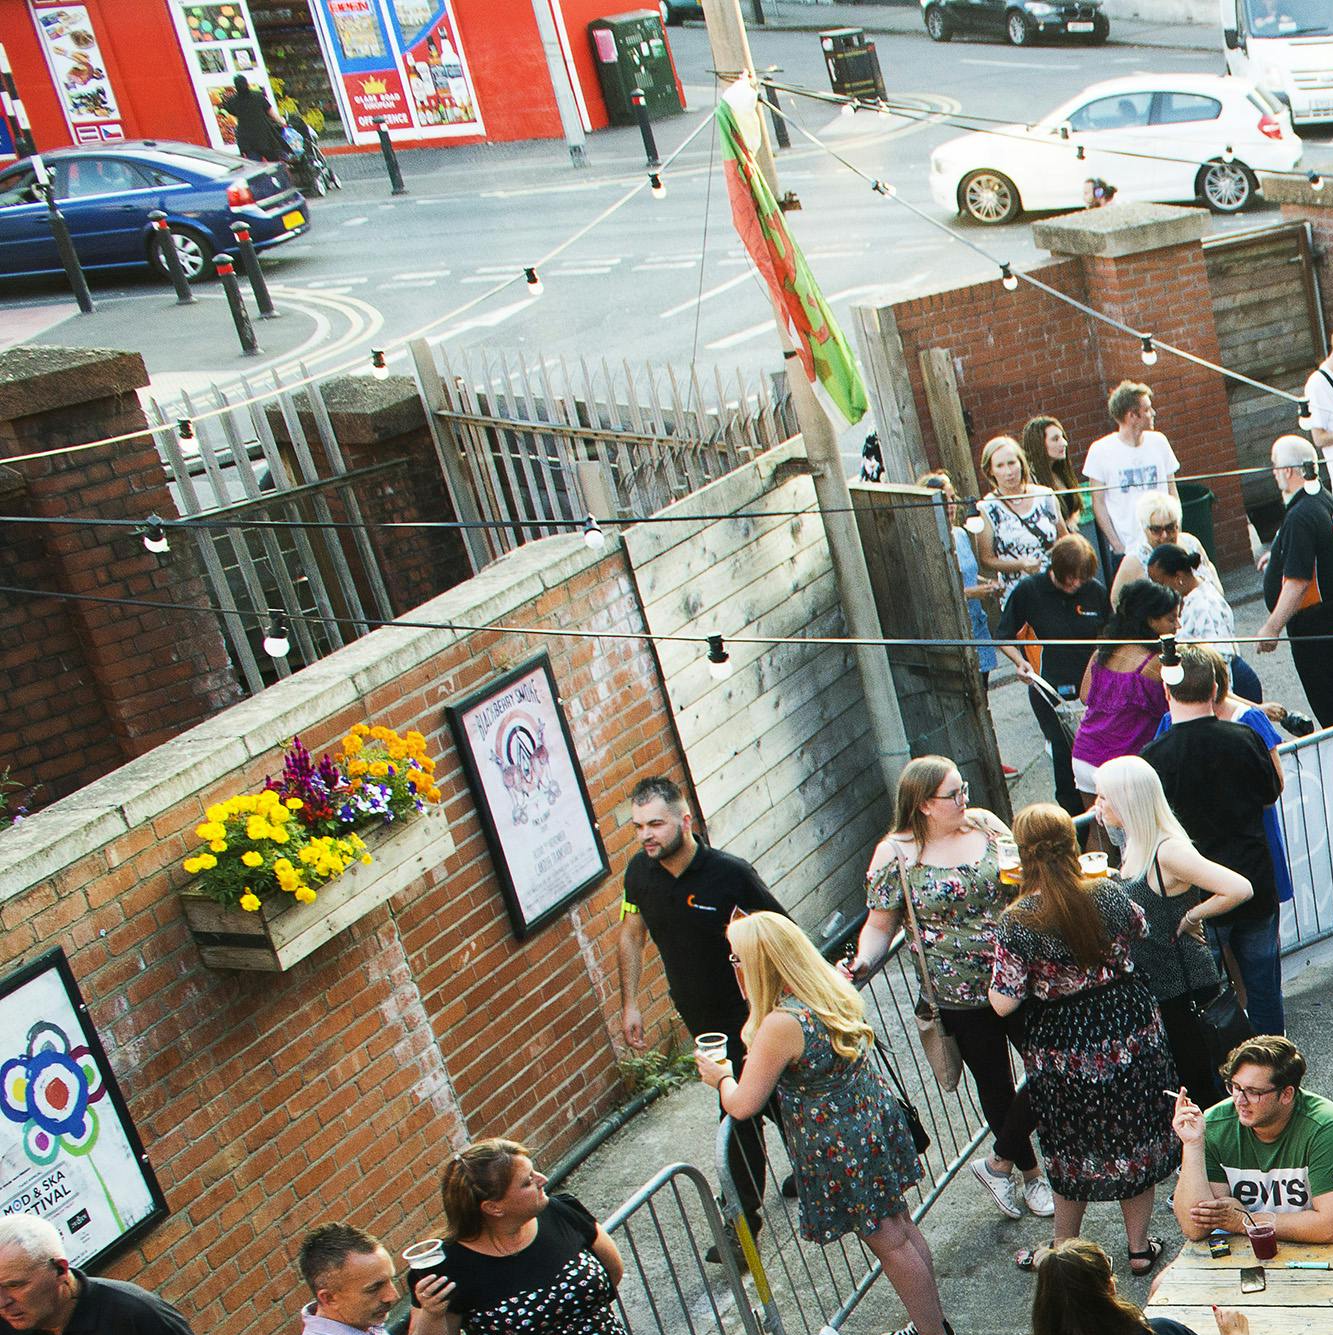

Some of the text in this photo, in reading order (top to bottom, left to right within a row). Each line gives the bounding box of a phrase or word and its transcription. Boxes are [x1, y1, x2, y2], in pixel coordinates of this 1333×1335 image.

[3, 1194, 31, 1216] MOD
[33, 1187, 42, 1198] &
[42, 1170, 66, 1191] SKA
[25, 1184, 71, 1215] TIVAL
